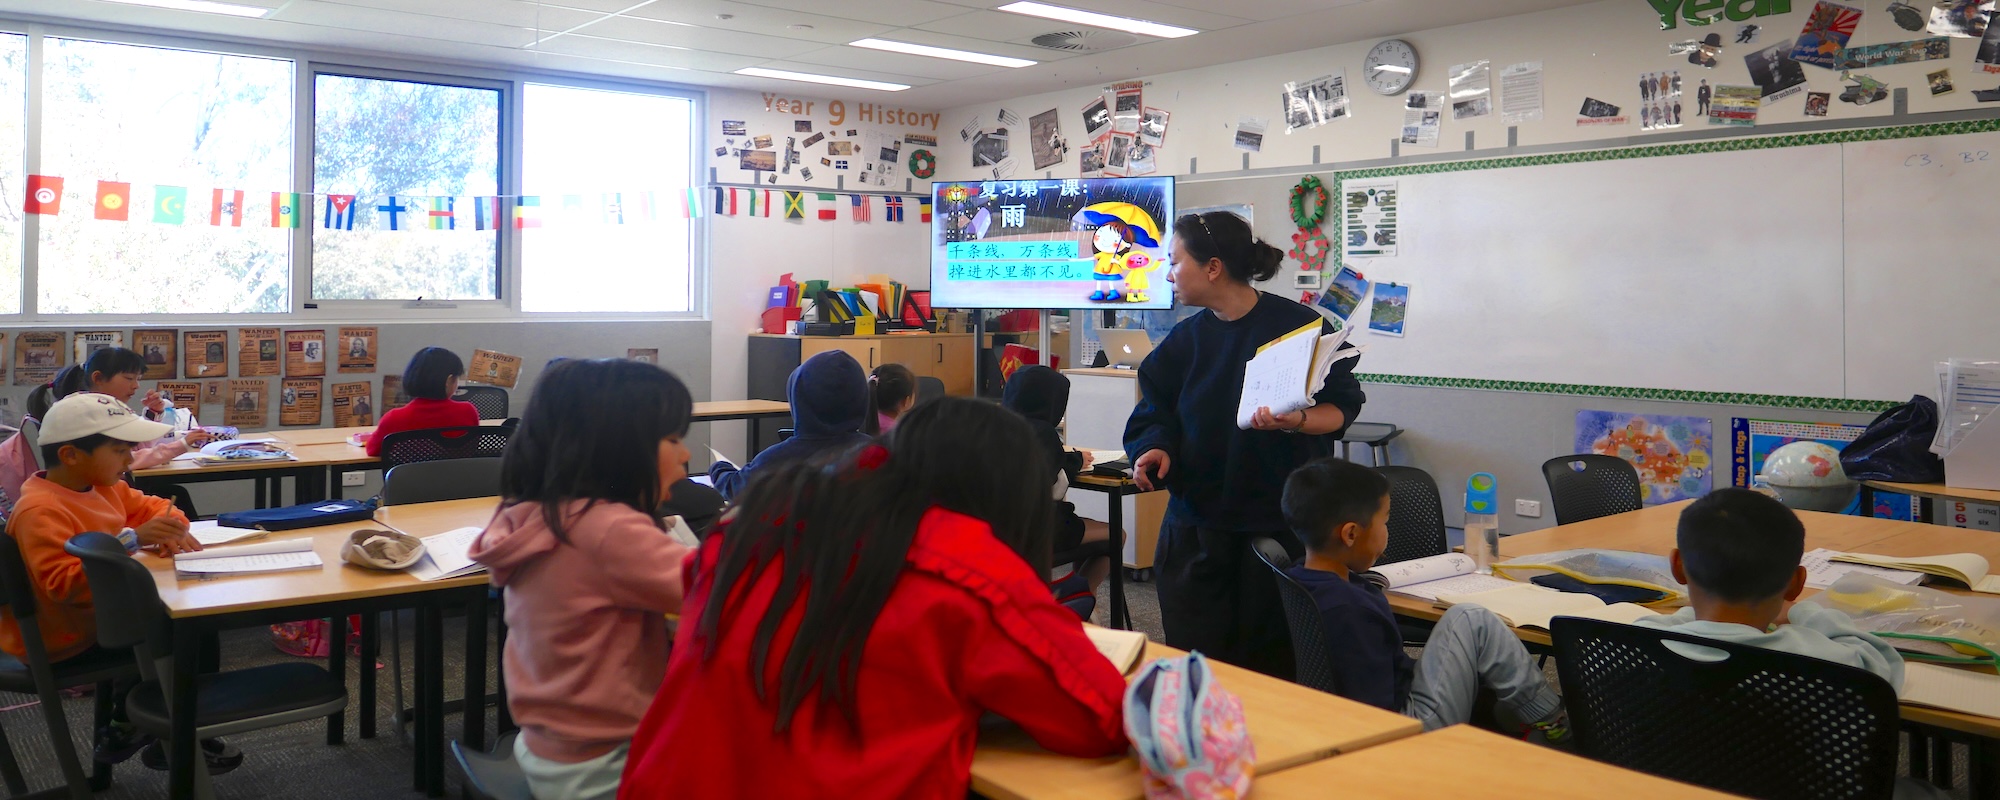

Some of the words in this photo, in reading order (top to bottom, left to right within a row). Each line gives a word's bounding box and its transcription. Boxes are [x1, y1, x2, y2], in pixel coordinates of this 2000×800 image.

[1855, 50, 1882, 62] World
[1885, 49, 1905, 57] War
[1770, 86, 1801, 102] Hiroshima
[761, 91, 814, 116] Year
[828, 99, 846, 126] 9
[859, 102, 940, 131] History
[1958, 150, 1989, 163] B2
[979, 179, 1088, 199] 复习第一课：
[1000, 203, 1026, 229] 雨
[949, 263, 1082, 279] 掉进水里都不见。
[483, 352, 514, 363] WANTED
[1736, 430, 1747, 454] Flags
[1736, 465, 1746, 487] Map
[1955, 501, 1966, 512] 5
[1977, 508, 1997, 516] cinq
[1955, 513, 1967, 523] 6
